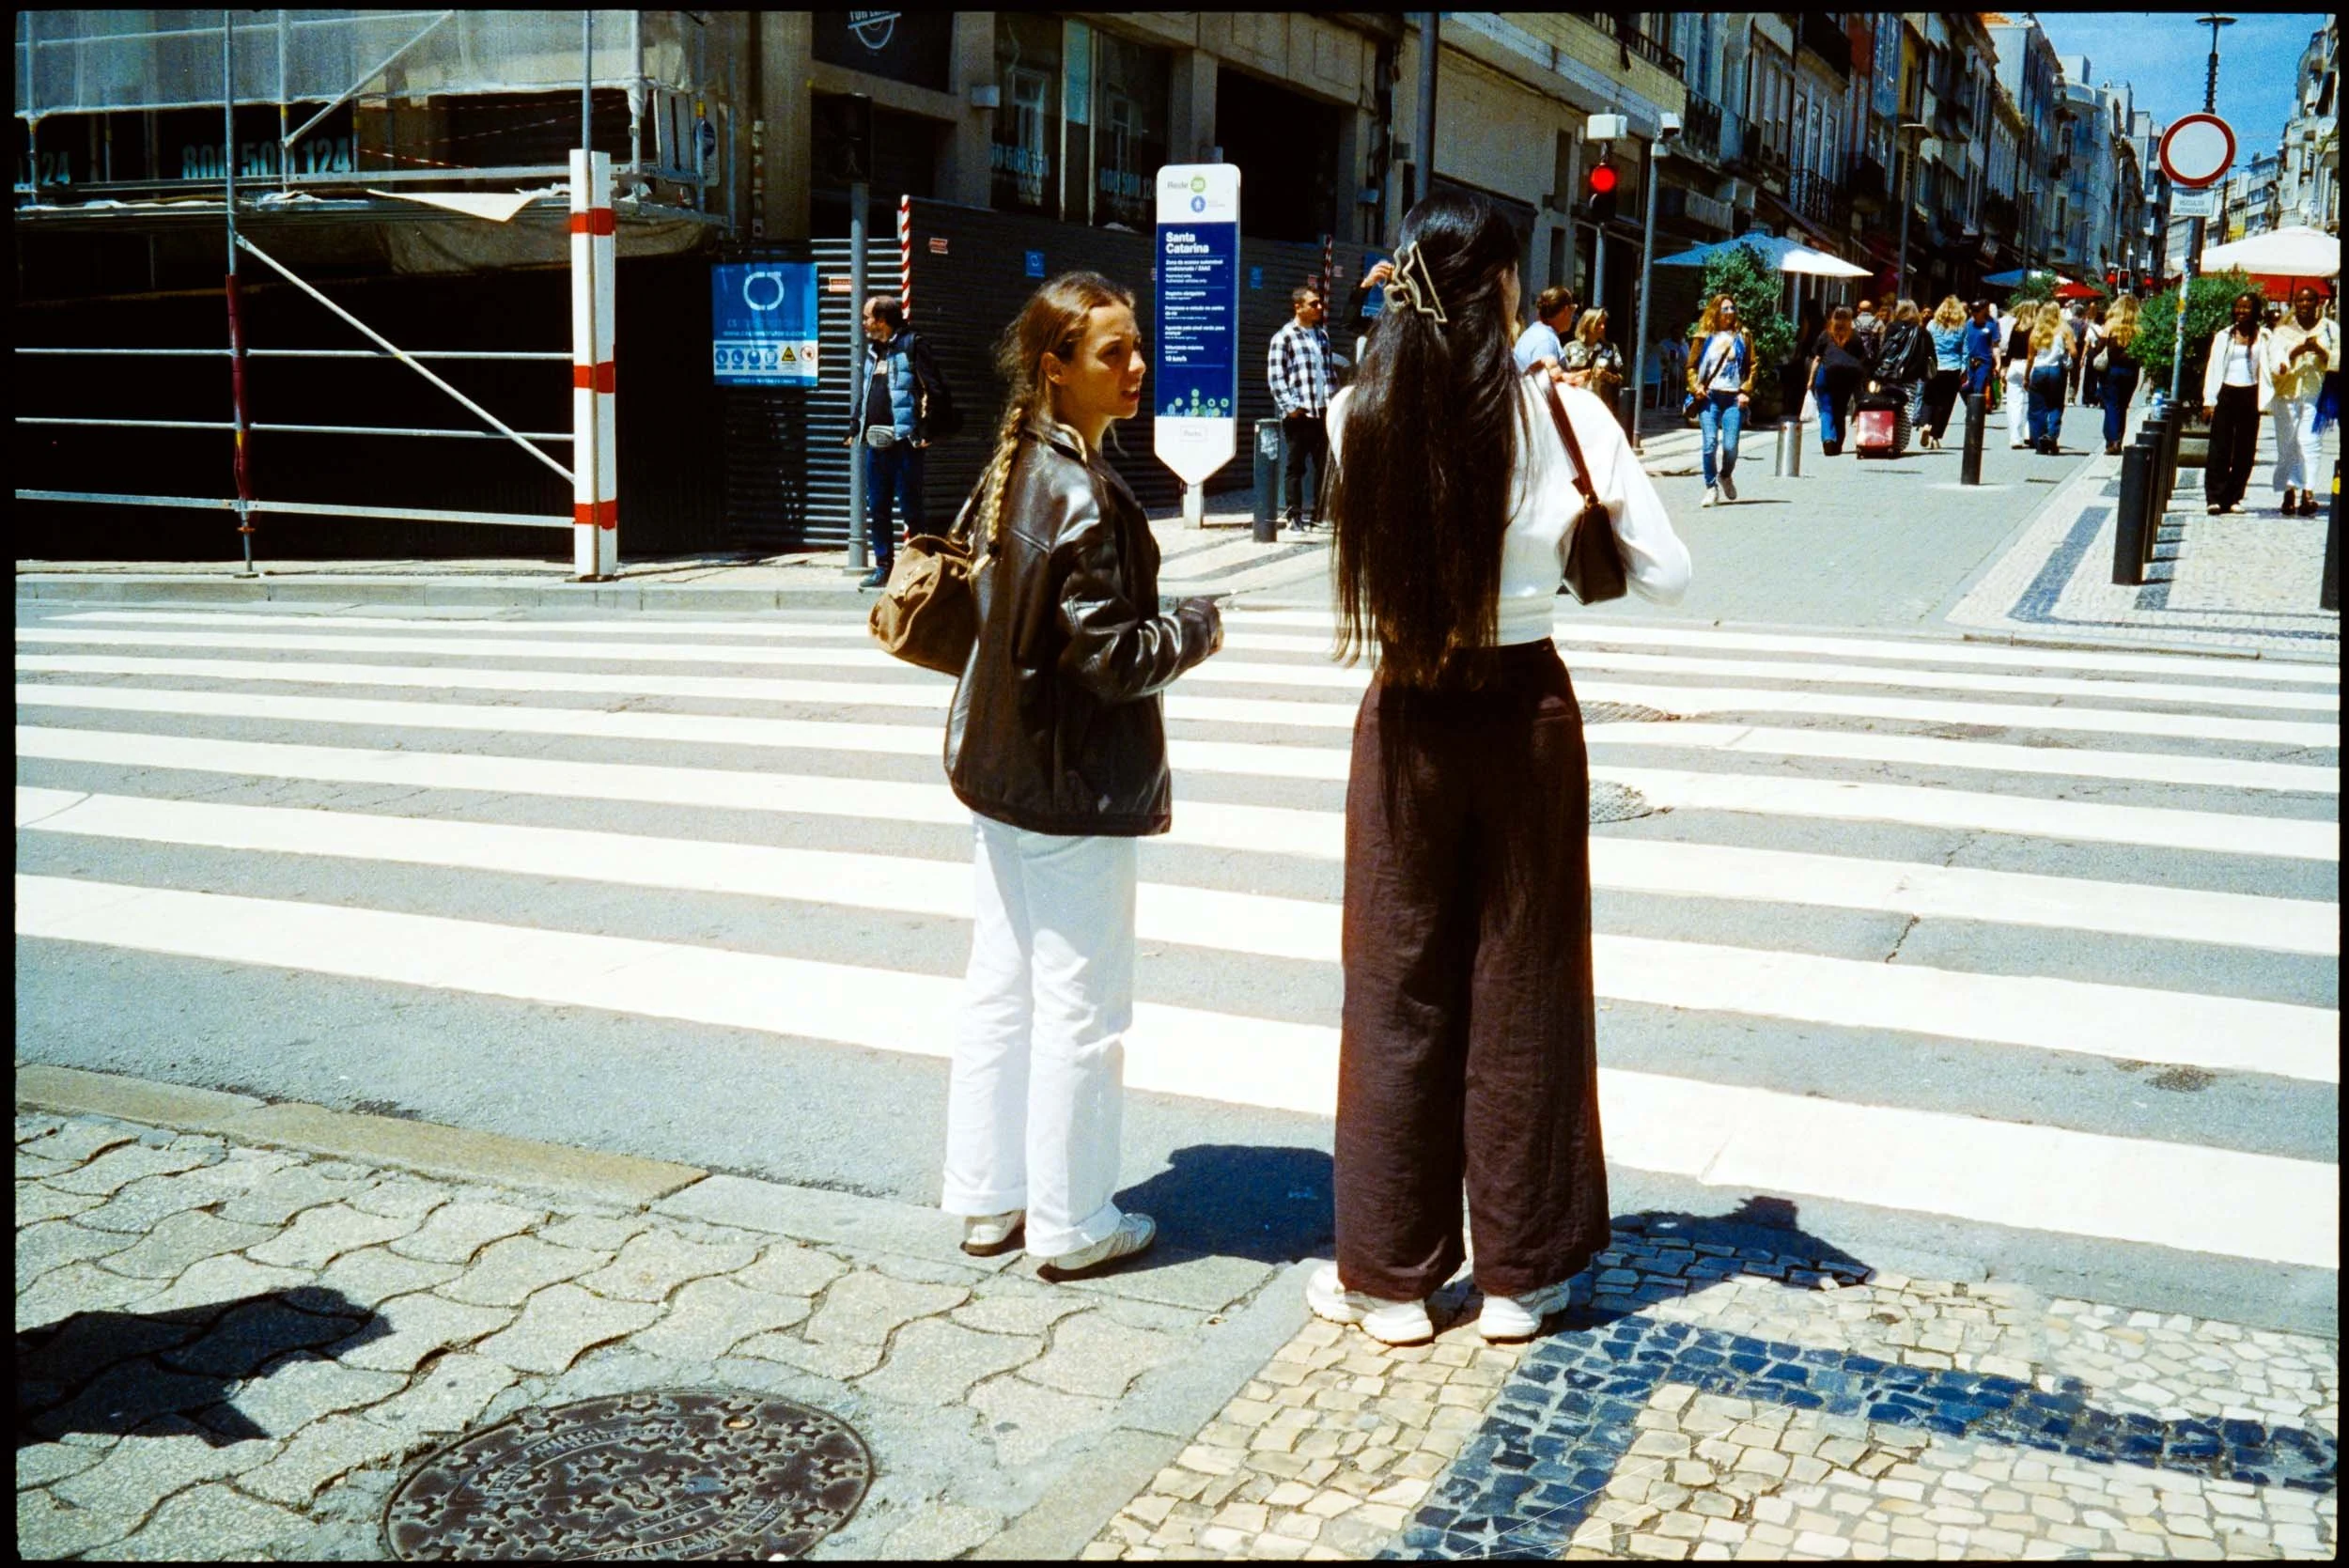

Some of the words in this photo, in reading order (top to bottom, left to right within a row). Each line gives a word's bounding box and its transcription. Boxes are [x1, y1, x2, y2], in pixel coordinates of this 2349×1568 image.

[302, 137, 351, 174] 124
[1165, 231, 1196, 243] Santa
[1165, 242, 1210, 255] Catarina
